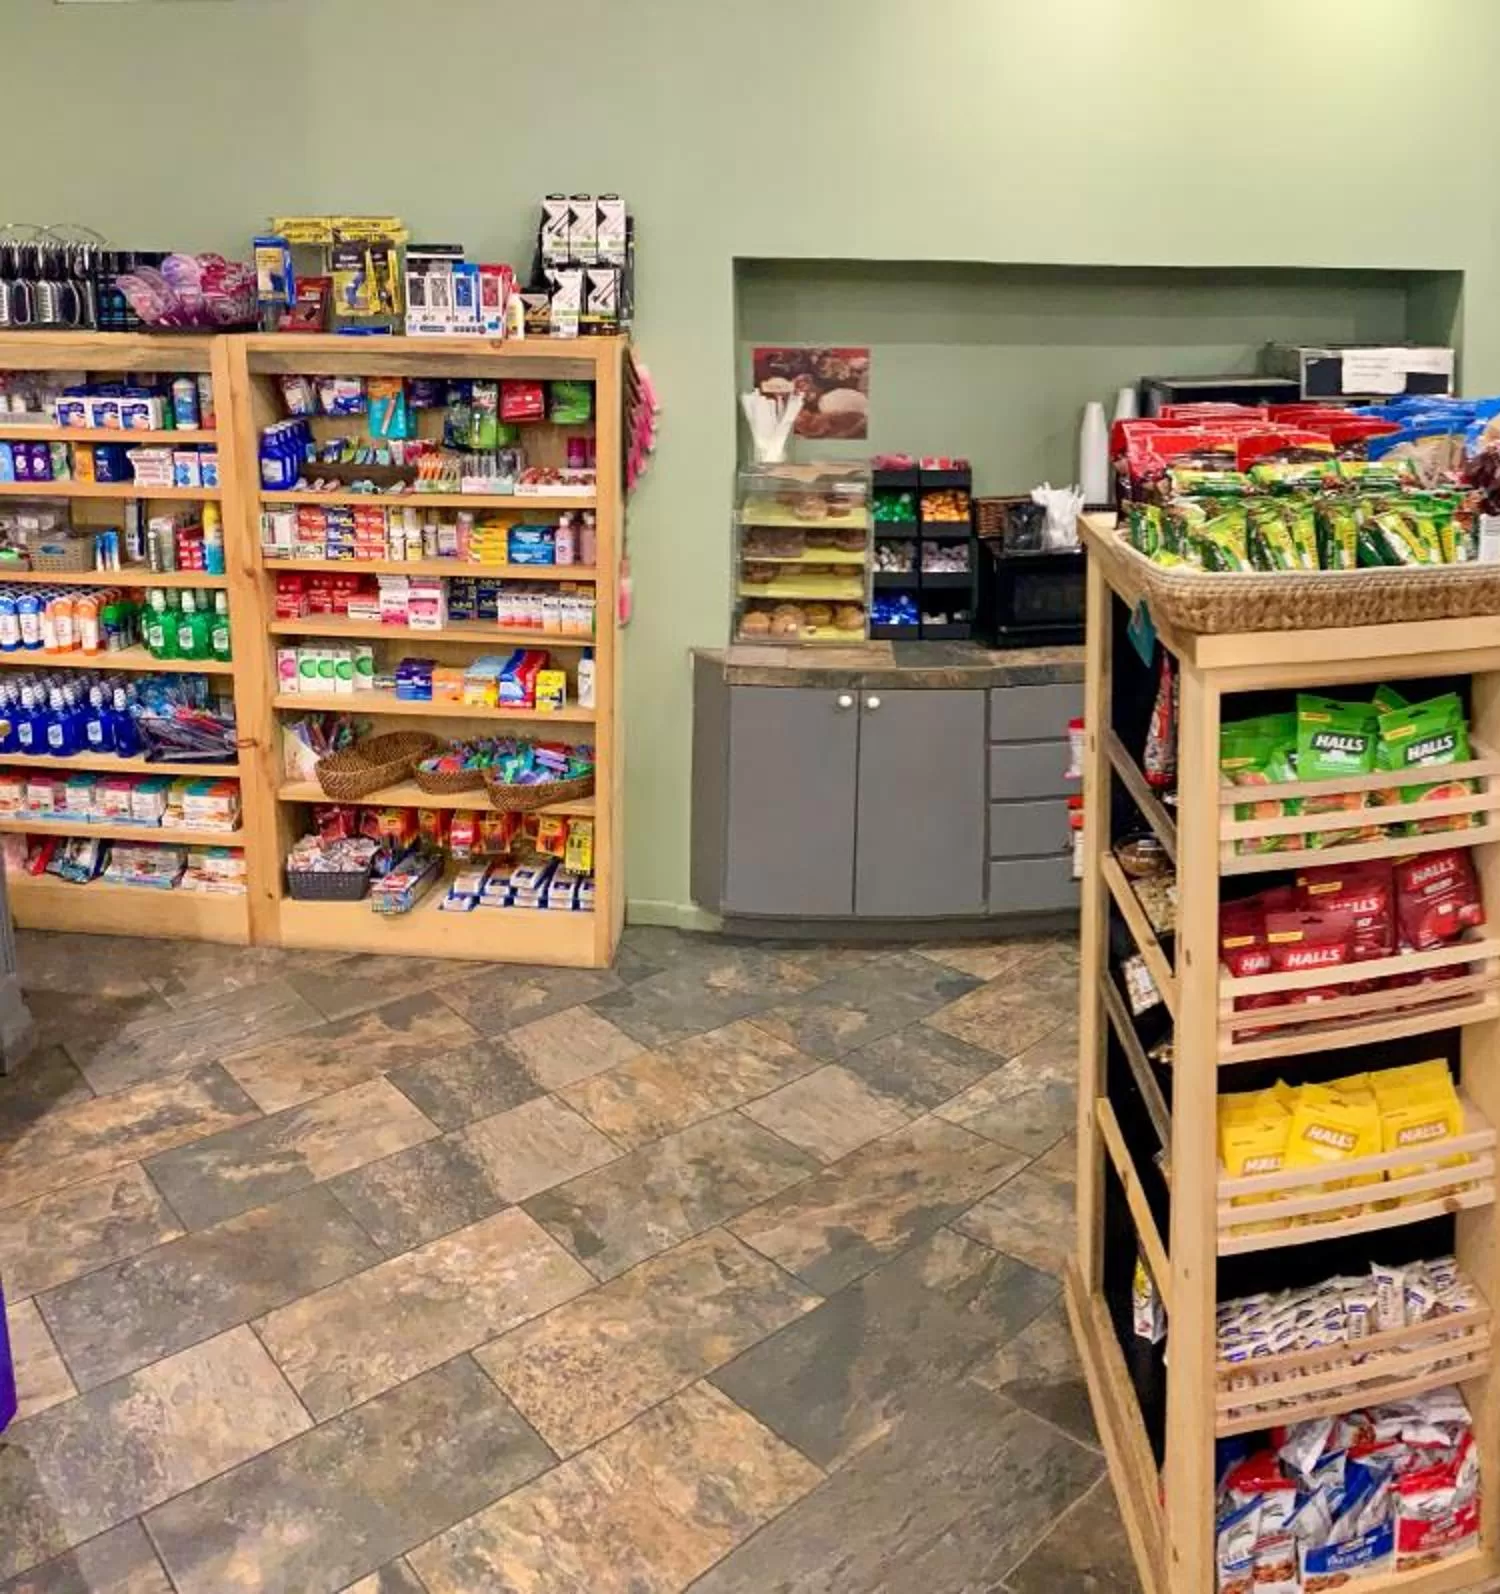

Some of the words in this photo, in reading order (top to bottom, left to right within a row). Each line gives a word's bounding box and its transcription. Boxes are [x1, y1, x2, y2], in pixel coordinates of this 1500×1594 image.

[1315, 733, 1365, 752] HALLS
[1407, 735, 1454, 761] HALLS
[1411, 857, 1456, 885] HALLS
[1287, 949, 1341, 968] HALLS
[1305, 1124, 1356, 1150] HALLS
